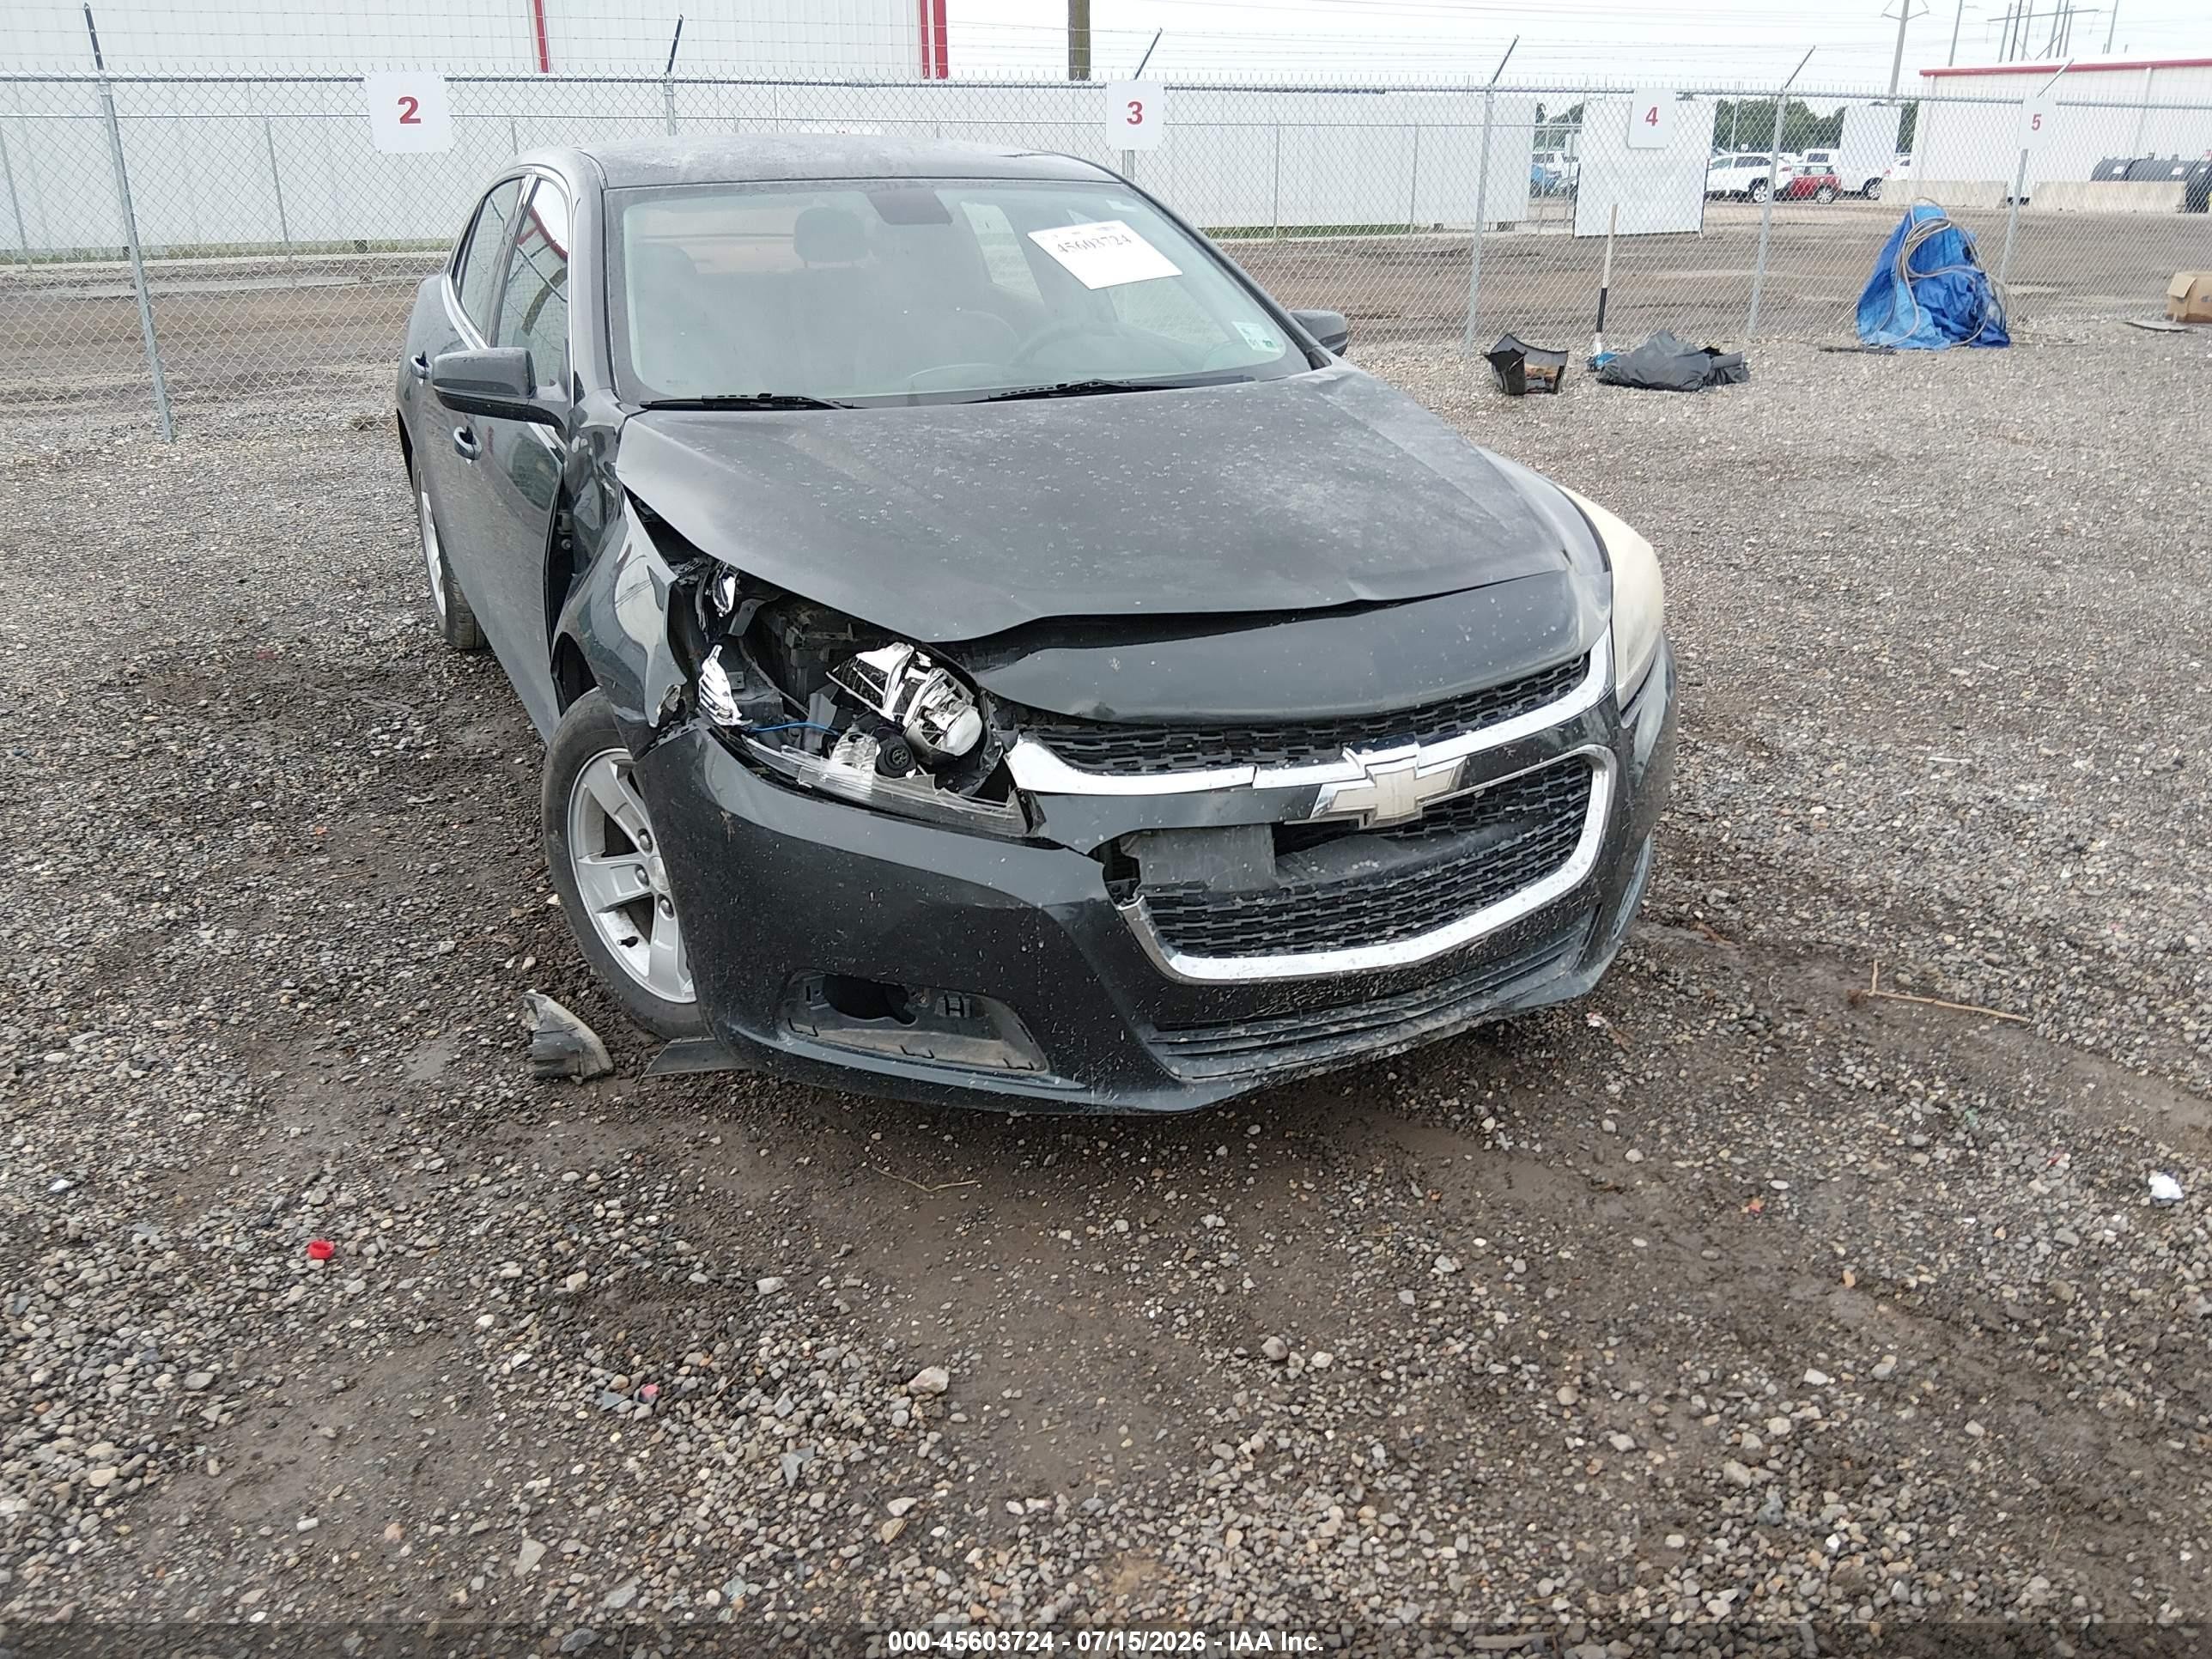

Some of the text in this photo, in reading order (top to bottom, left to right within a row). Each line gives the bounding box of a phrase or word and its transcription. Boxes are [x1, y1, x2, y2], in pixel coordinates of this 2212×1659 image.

[398, 96, 422, 125] 2
[1127, 101, 1143, 125] 3
[1645, 106, 1658, 126] 4
[2032, 113, 2042, 131] 5
[1057, 234, 1132, 253] 45603724
